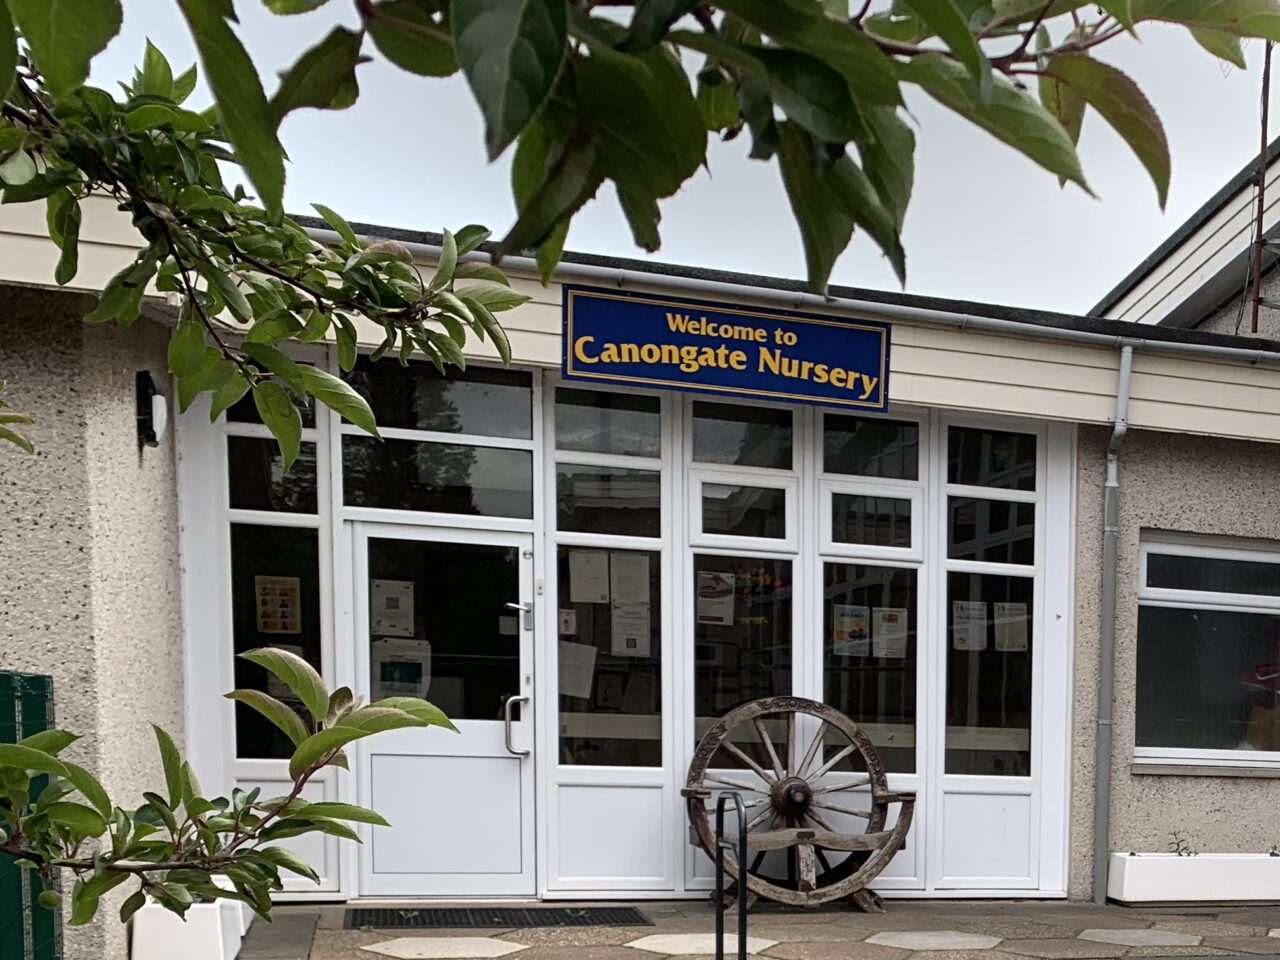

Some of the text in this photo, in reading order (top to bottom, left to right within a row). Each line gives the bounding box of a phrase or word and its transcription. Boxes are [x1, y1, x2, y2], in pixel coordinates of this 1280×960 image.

[665, 312, 798, 346] Welcome to
[574, 335, 878, 400] Canongate Nursery
